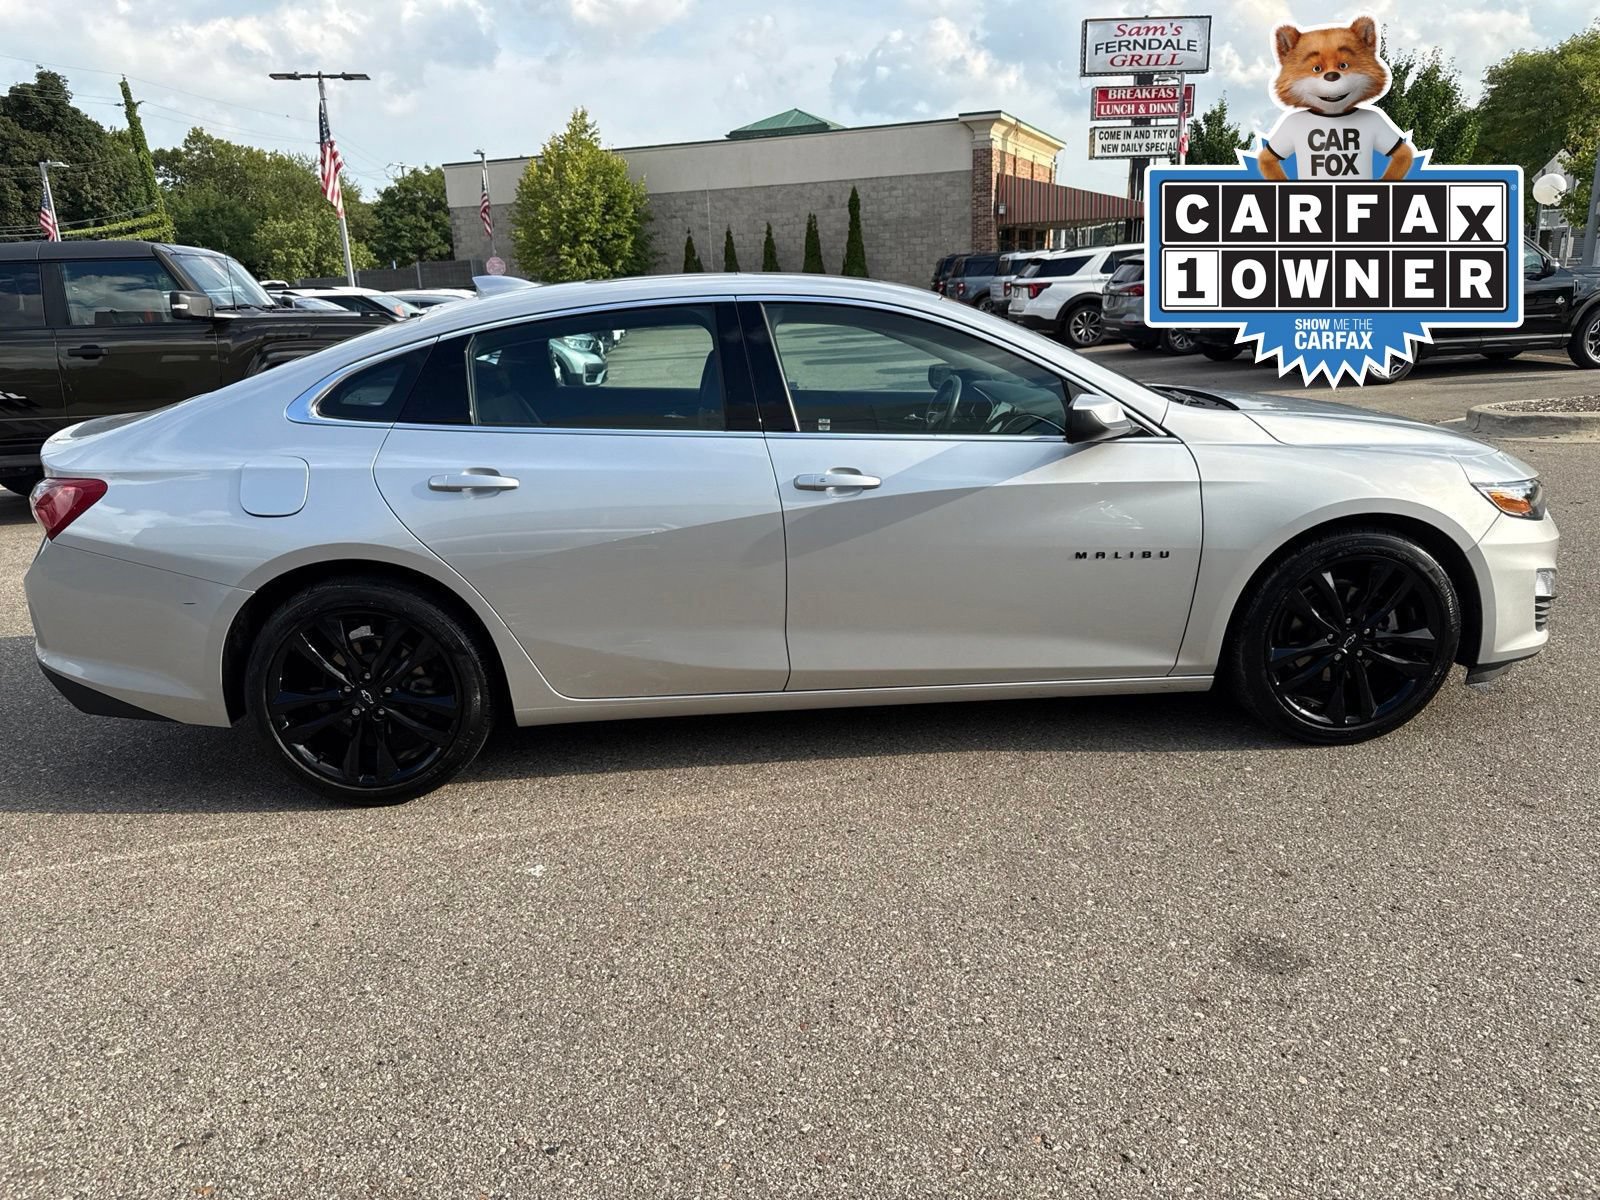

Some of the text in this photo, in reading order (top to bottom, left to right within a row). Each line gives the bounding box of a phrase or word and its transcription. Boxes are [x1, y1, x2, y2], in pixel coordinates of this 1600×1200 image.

[1114, 22, 1183, 37] Sam's
[1095, 38, 1198, 56] FERNDALE
[1109, 53, 1184, 67] GRILL
[1107, 88, 1180, 100] BREAKFAST
[1100, 103, 1135, 115] LUNCH
[1138, 103, 1146, 114] &
[1098, 130, 1121, 141] COME
[1123, 130, 1132, 140] IN
[1133, 129, 1151, 140] AND
[1153, 129, 1168, 139] TRY
[1101, 143, 1119, 153] NEW
[1121, 142, 1144, 153] DAILY
[1075, 550, 1170, 560] MALIBU
